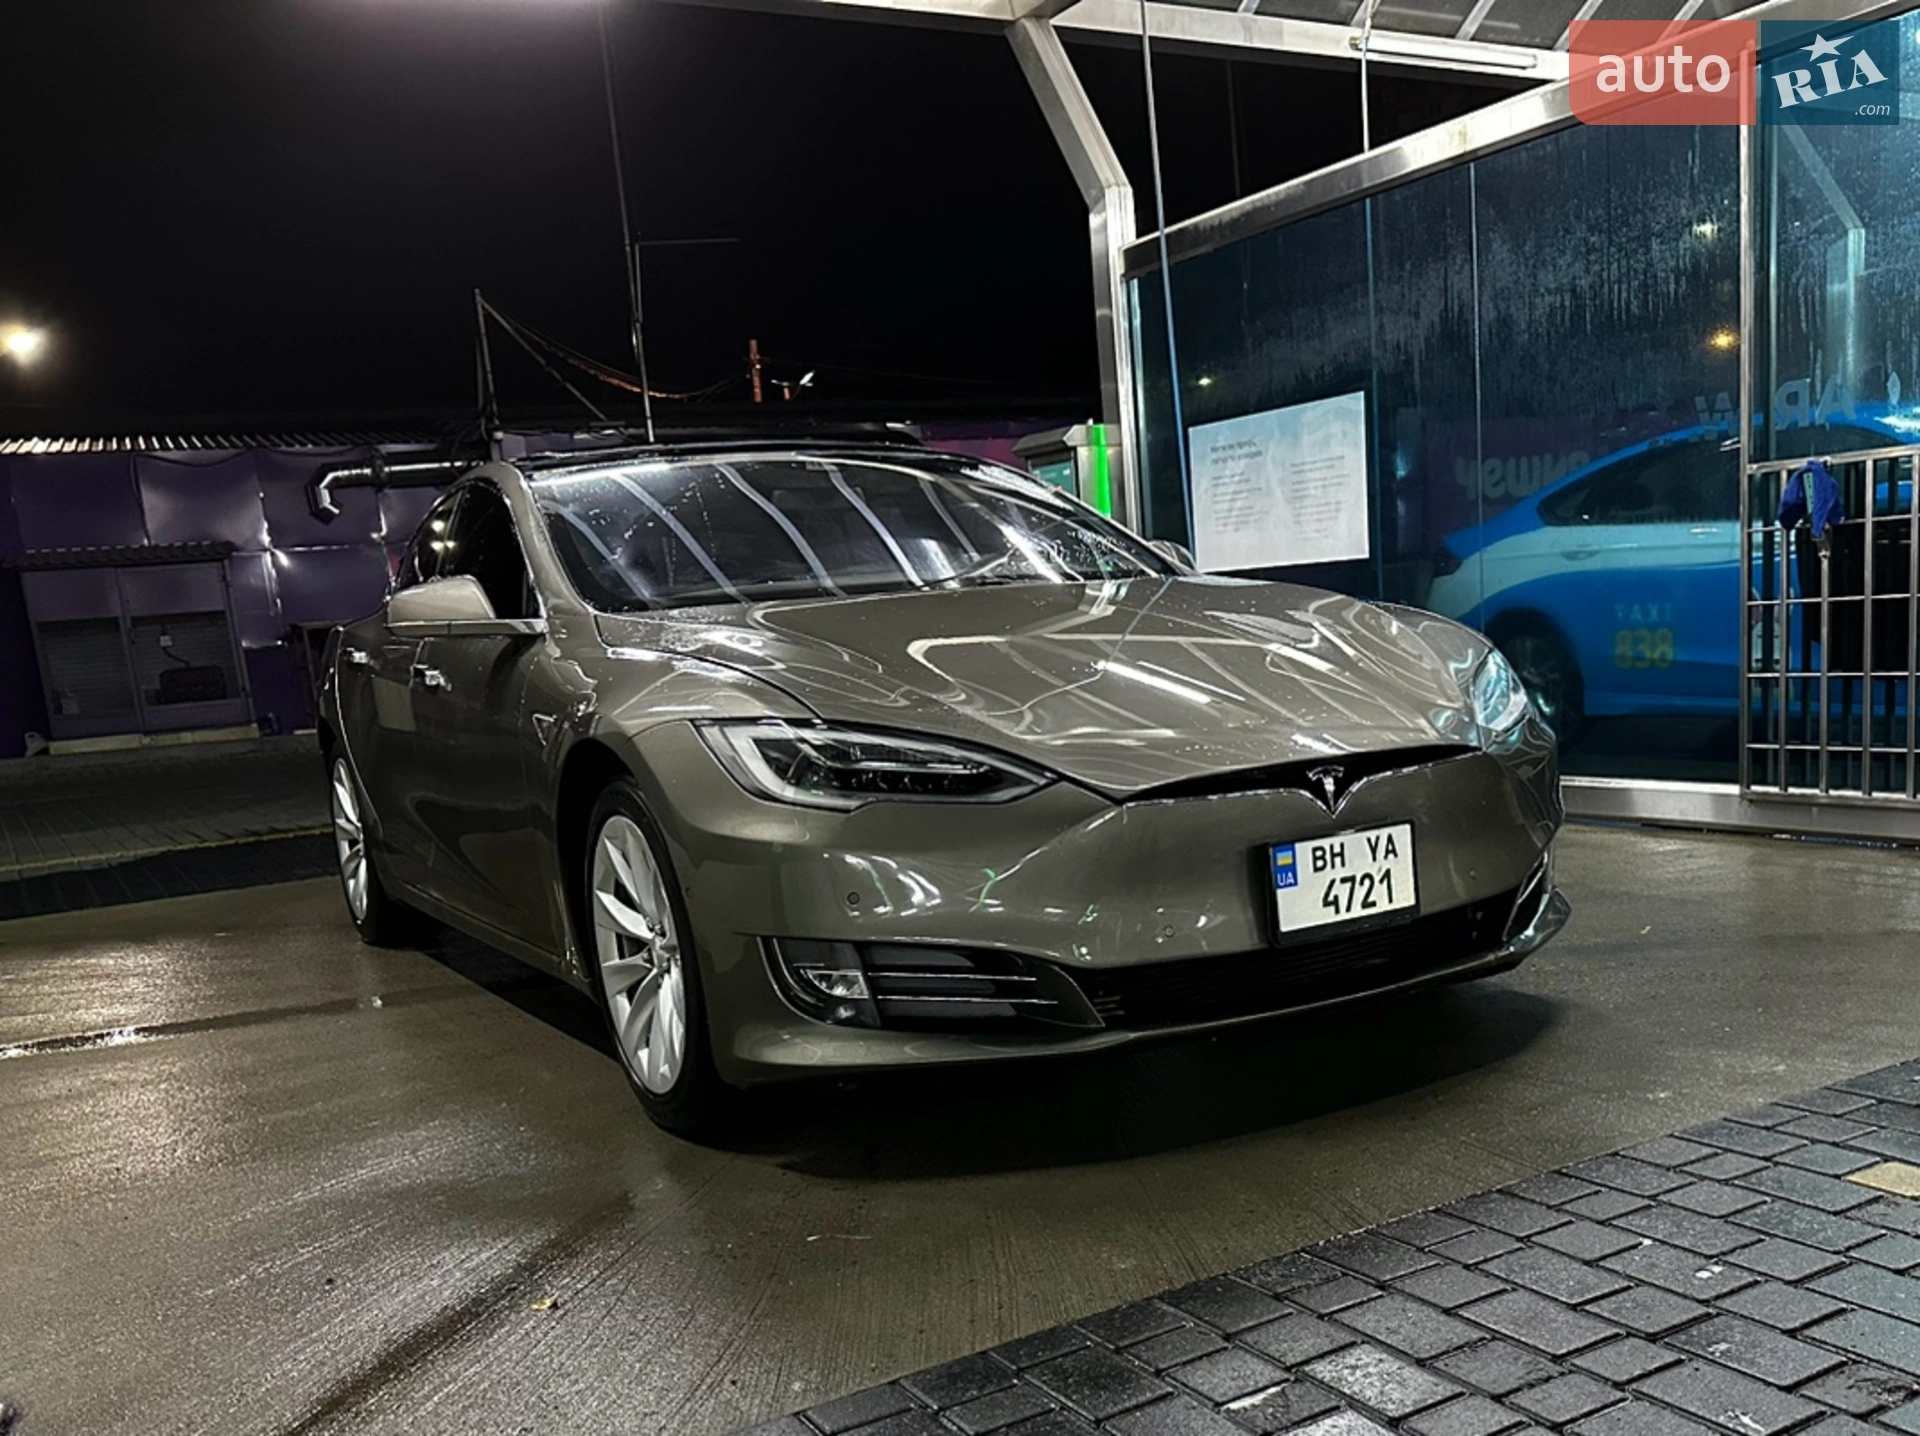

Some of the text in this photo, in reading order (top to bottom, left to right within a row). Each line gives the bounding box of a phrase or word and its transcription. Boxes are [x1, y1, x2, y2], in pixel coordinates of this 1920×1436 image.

[1613, 602, 1672, 622] TAXI
[1311, 833, 1398, 873] BH YA
[1277, 872, 1295, 886] UA
[1322, 868, 1393, 915] 4721
